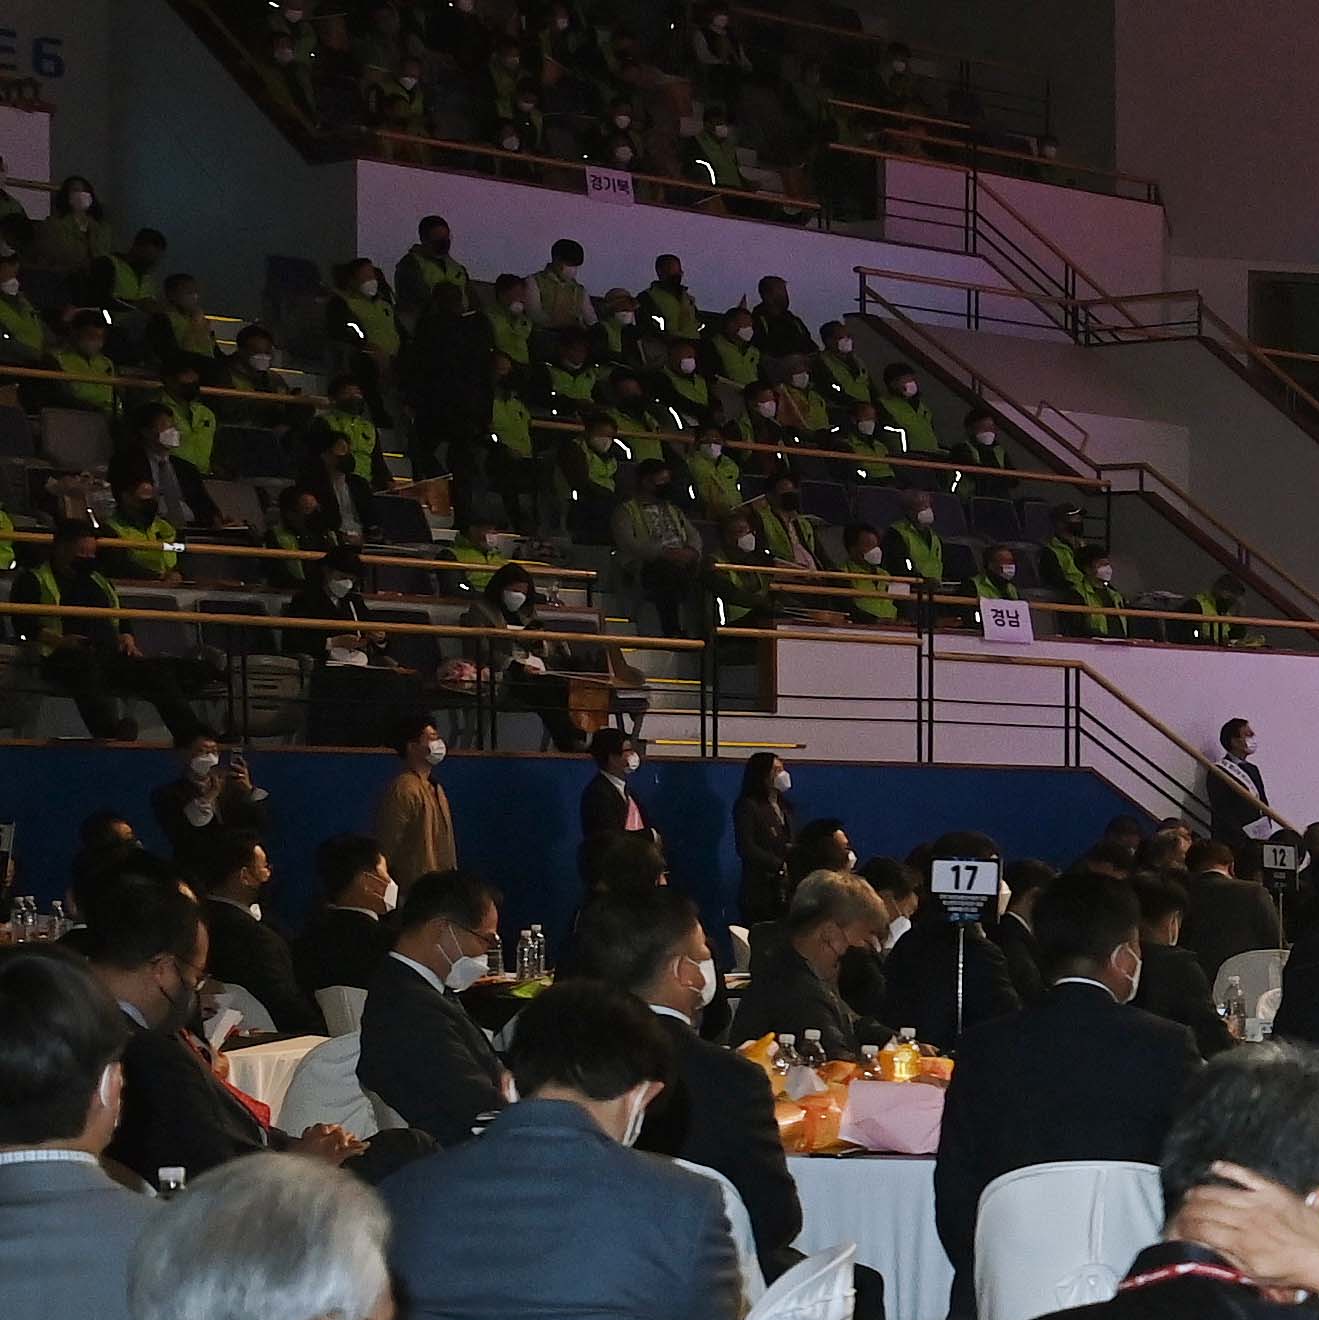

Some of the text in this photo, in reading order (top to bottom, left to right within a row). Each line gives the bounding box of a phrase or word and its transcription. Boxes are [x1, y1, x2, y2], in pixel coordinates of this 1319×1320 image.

[990, 608, 1020, 628] 경남
[1272, 848, 1287, 867] 12
[950, 864, 979, 891] 17
